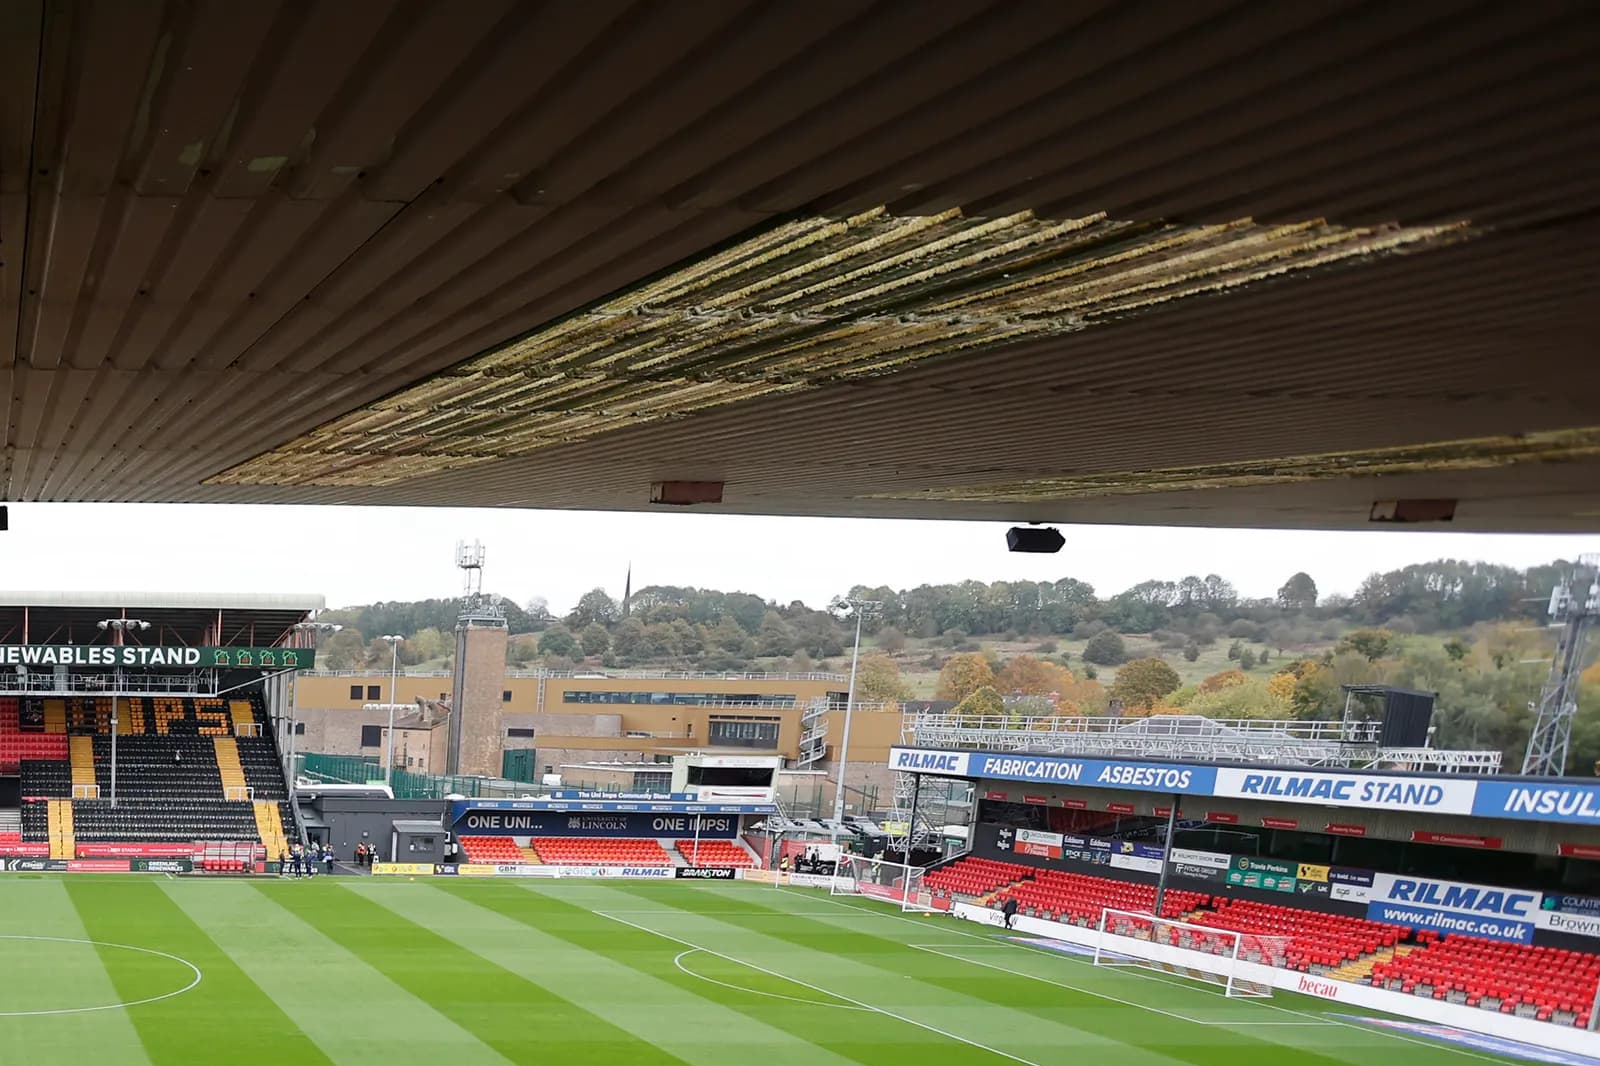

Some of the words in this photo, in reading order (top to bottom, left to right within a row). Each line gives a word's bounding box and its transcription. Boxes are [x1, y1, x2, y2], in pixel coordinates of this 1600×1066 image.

[122, 647, 201, 664] STAND
[897, 752, 959, 771] RILMAC
[982, 758, 1083, 781] FABRICATION
[1097, 765, 1192, 789] ASBESTOS
[602, 792, 618, 800] Imps
[618, 792, 651, 801] Community
[1240, 774, 1356, 801] RILMAC
[1359, 781, 1444, 806] STAND
[1503, 788, 1600, 816] INSUL
[467, 815, 500, 829] ONE
[504, 815, 543, 829] UNI...
[582, 821, 627, 830] LINCOLN
[652, 818, 685, 831] ONE
[688, 818, 730, 832] IMPS!
[498, 865, 517, 873] GBM
[622, 868, 669, 877] RILMAC
[682, 868, 731, 878] BRANSTON
[1250, 861, 1267, 870] Travis
[1269, 864, 1289, 874] Perkins
[1388, 879, 1535, 917] RILMAC
[1384, 909, 1527, 940] www.rilmac.co.uk
[1298, 975, 1338, 998] becau
